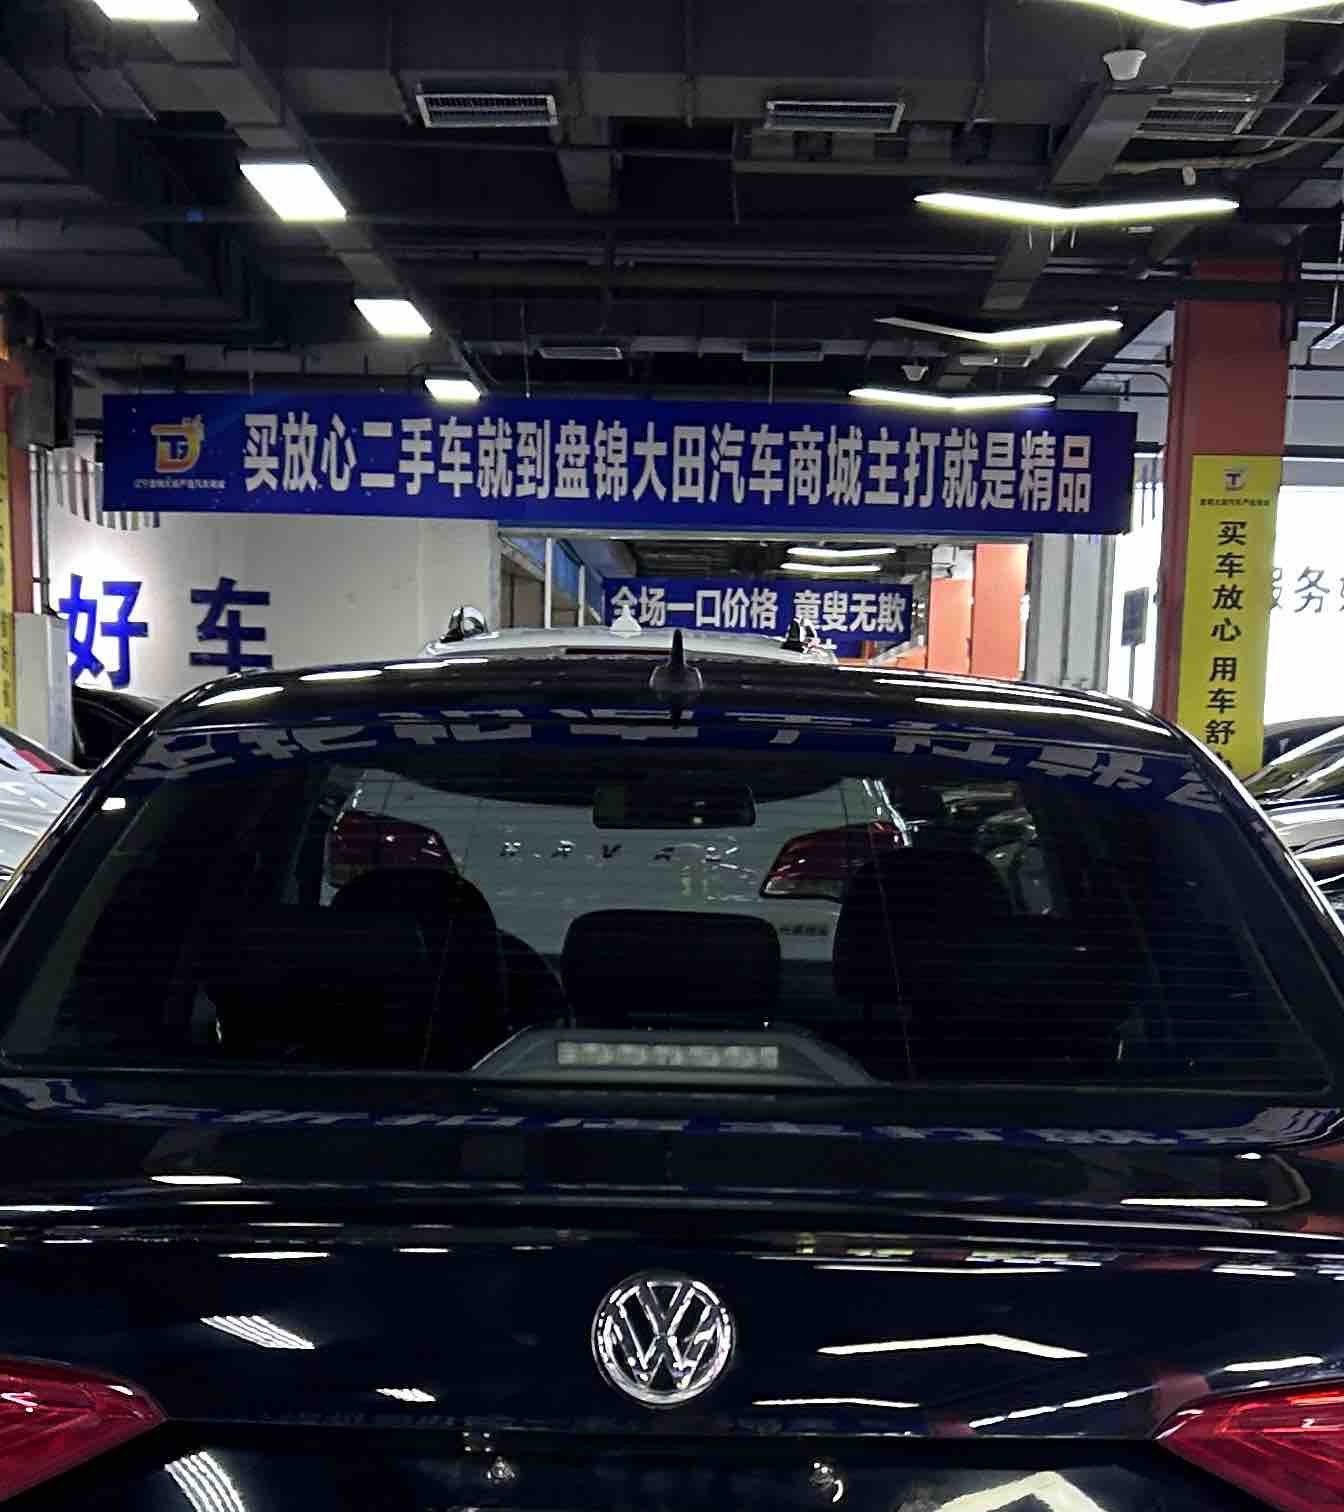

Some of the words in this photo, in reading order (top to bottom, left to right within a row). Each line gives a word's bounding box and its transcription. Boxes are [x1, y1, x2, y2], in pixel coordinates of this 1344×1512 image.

[242, 410, 1093, 513] 买放心二手车就到盘锦大田汽车商城主打就是精品
[611, 585, 778, 629] 全场一口价格
[1210, 520, 1248, 643] 买车放心
